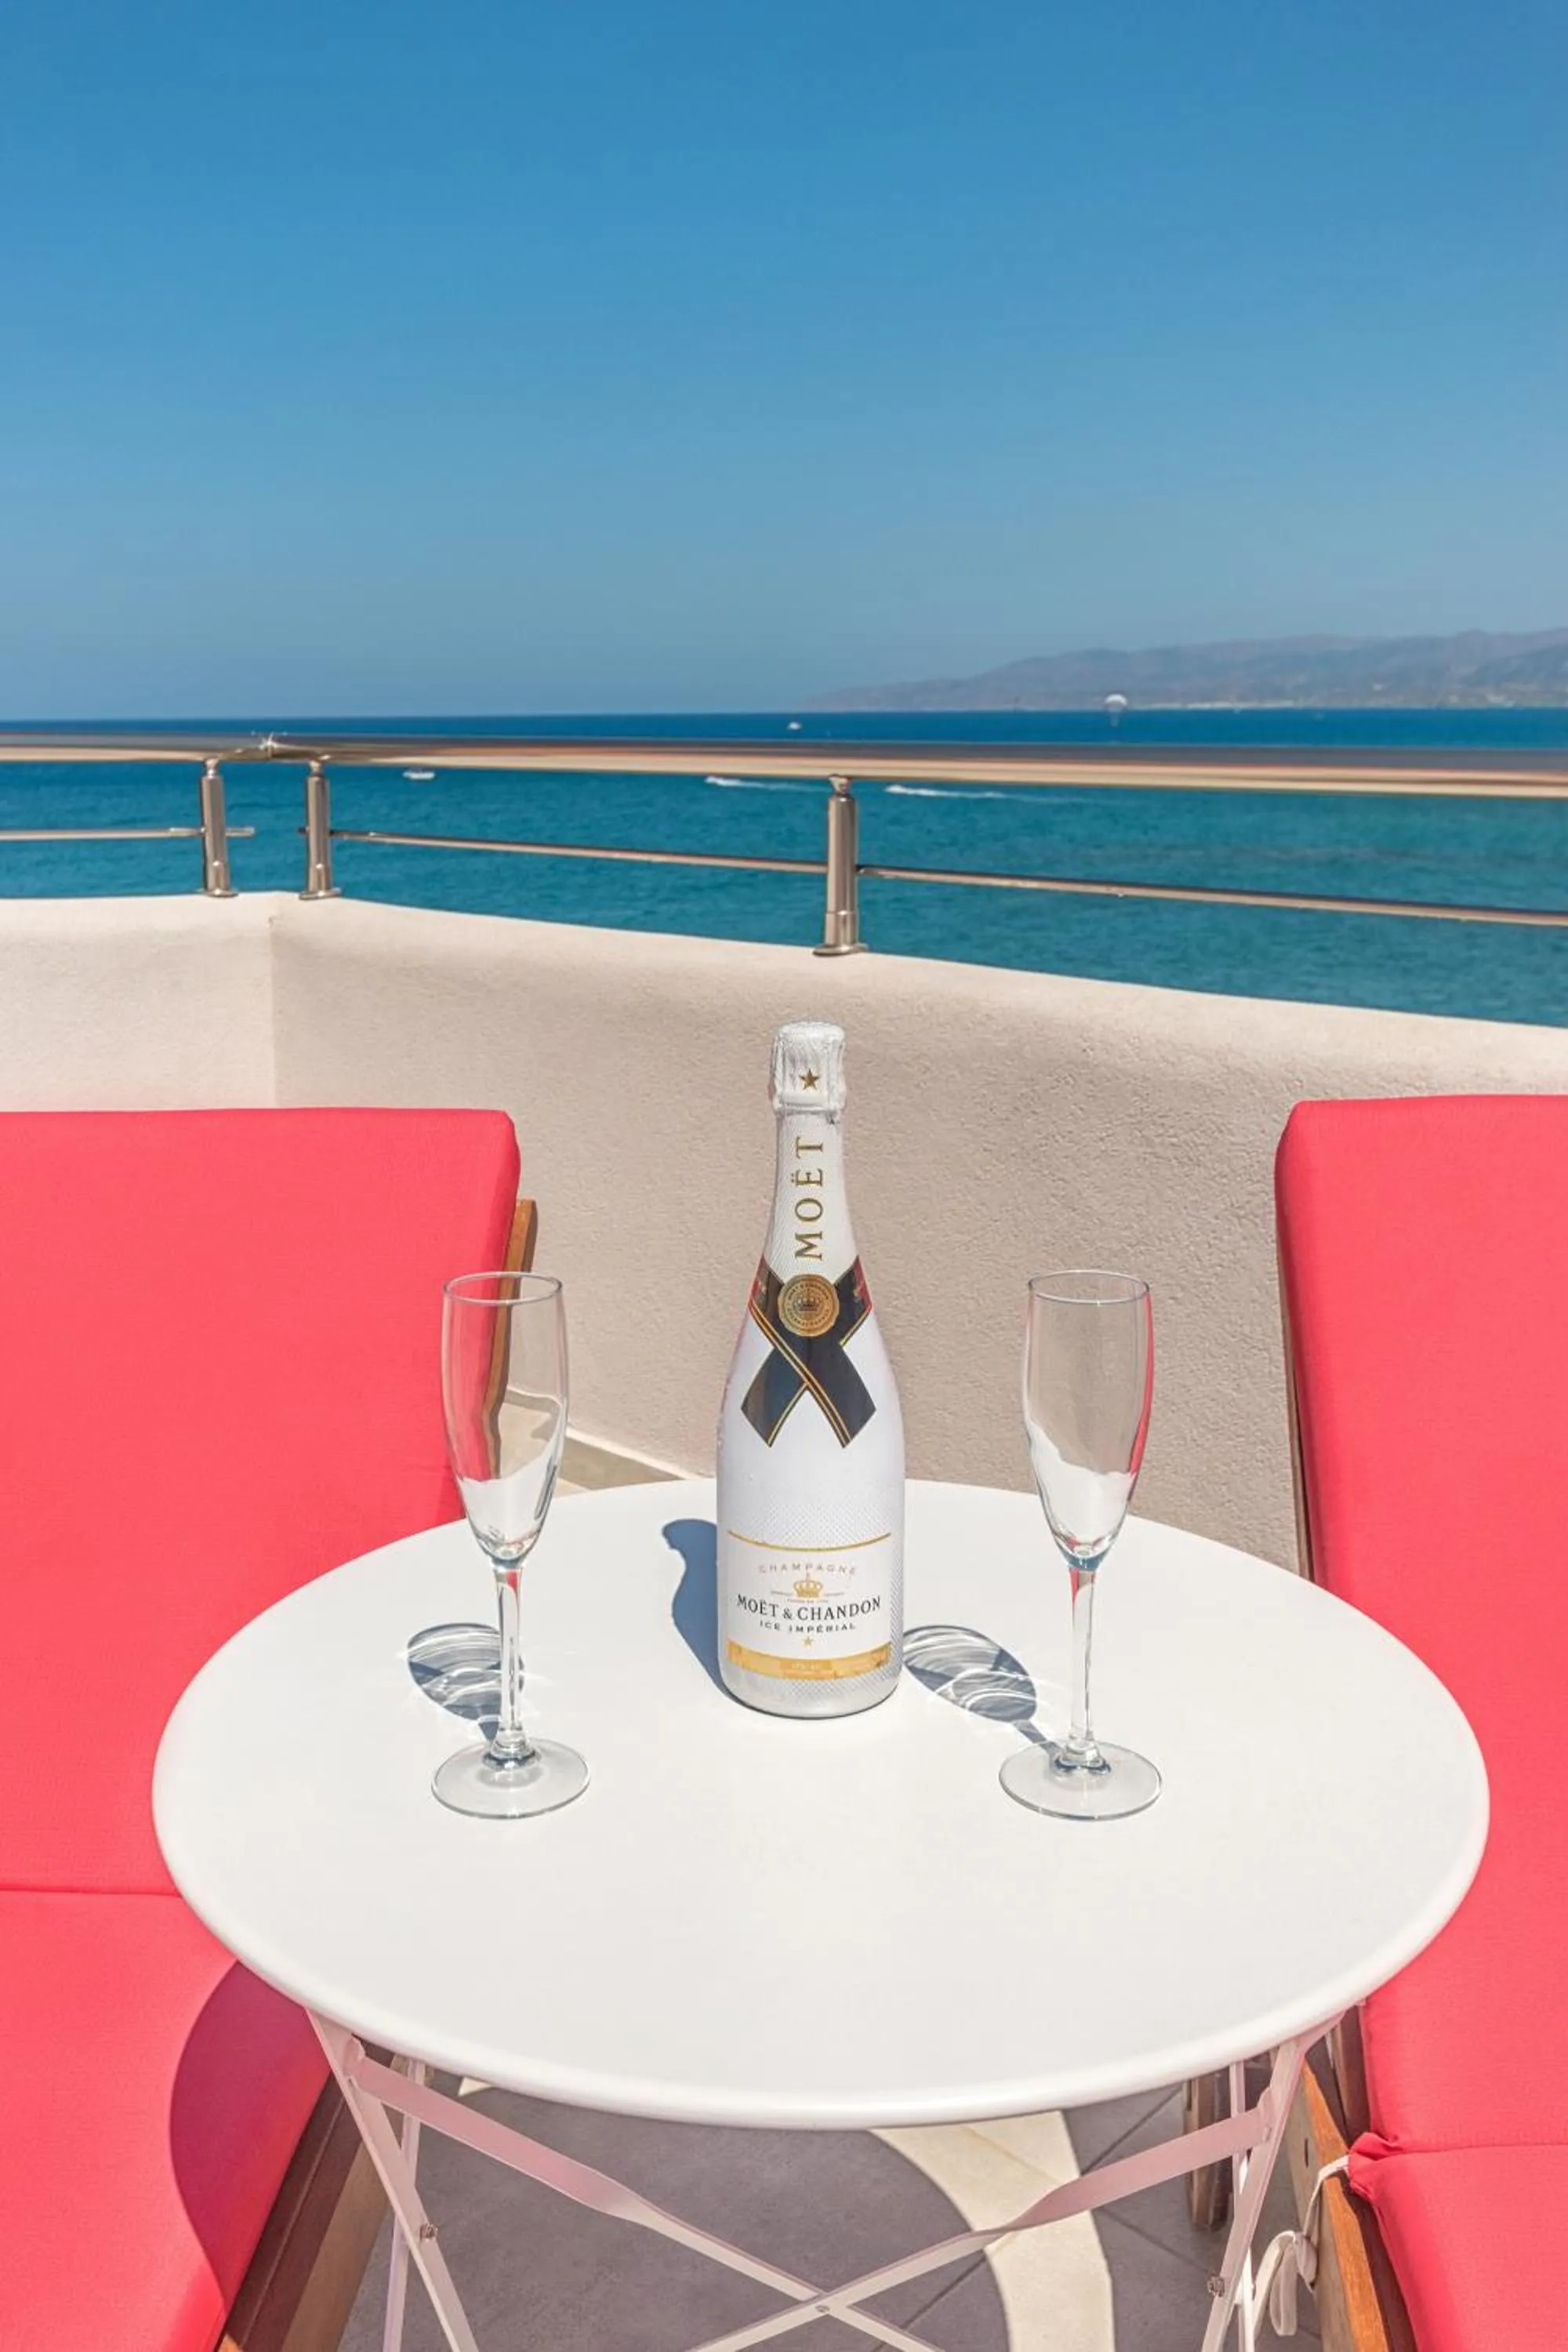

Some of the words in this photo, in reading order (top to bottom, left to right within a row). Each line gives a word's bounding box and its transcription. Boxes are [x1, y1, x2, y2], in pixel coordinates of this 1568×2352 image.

[791, 1135, 824, 1261] MOËT
[758, 1563, 856, 1575] CHAMPAGNE
[737, 1594, 779, 1617] MOËT
[782, 1607, 793, 1620] &
[797, 1595, 881, 1621] CHANDON
[760, 1621, 781, 1632] ICE
[789, 1622, 856, 1634] IMPÉRIAL
